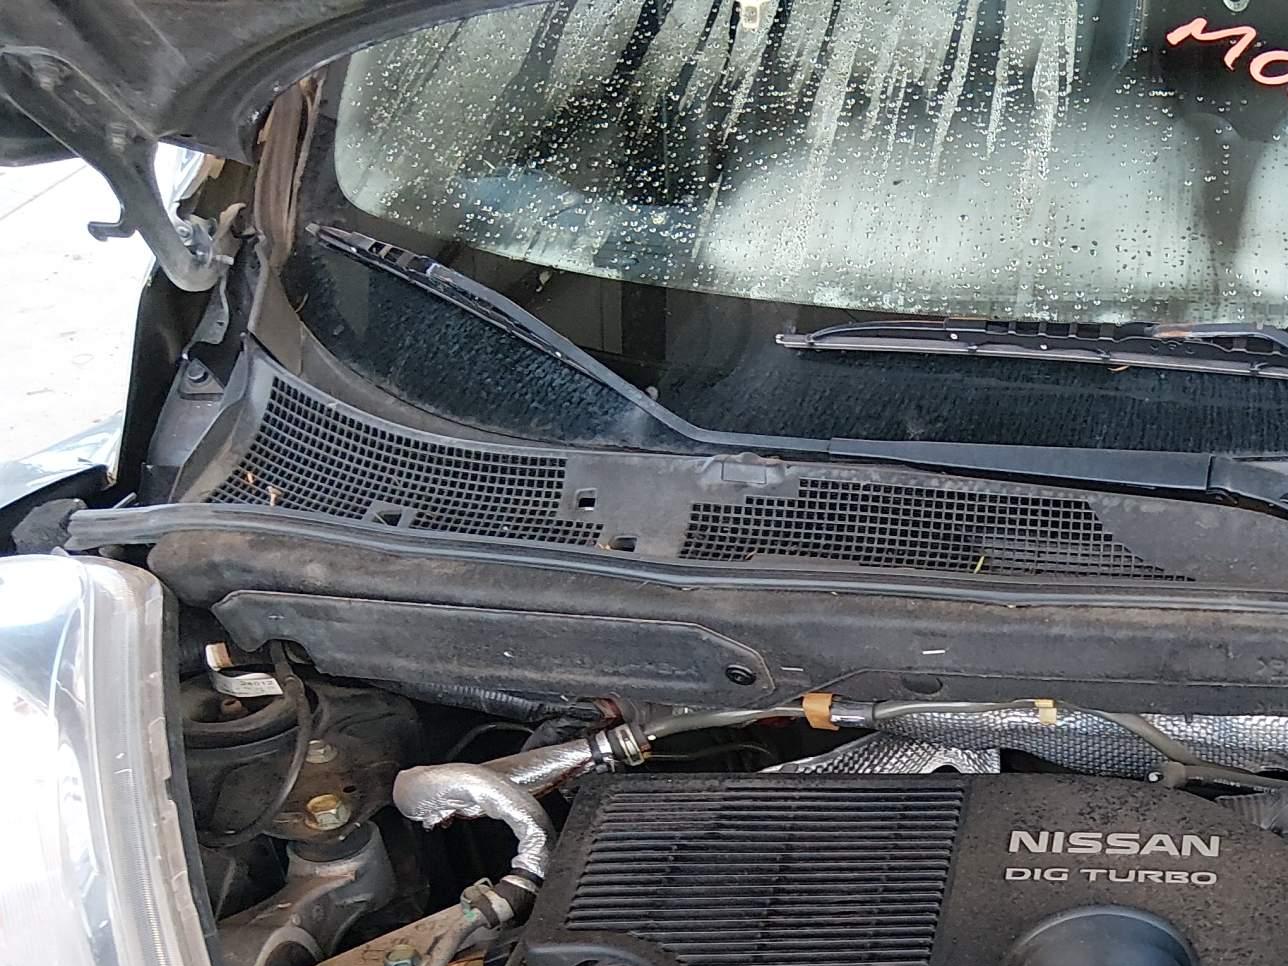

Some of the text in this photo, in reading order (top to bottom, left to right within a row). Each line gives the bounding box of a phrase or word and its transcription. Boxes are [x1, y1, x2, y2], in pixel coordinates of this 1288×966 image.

[1008, 830, 1220, 857] NISSAN
[1004, 867, 1218, 885] DIG TURBO
